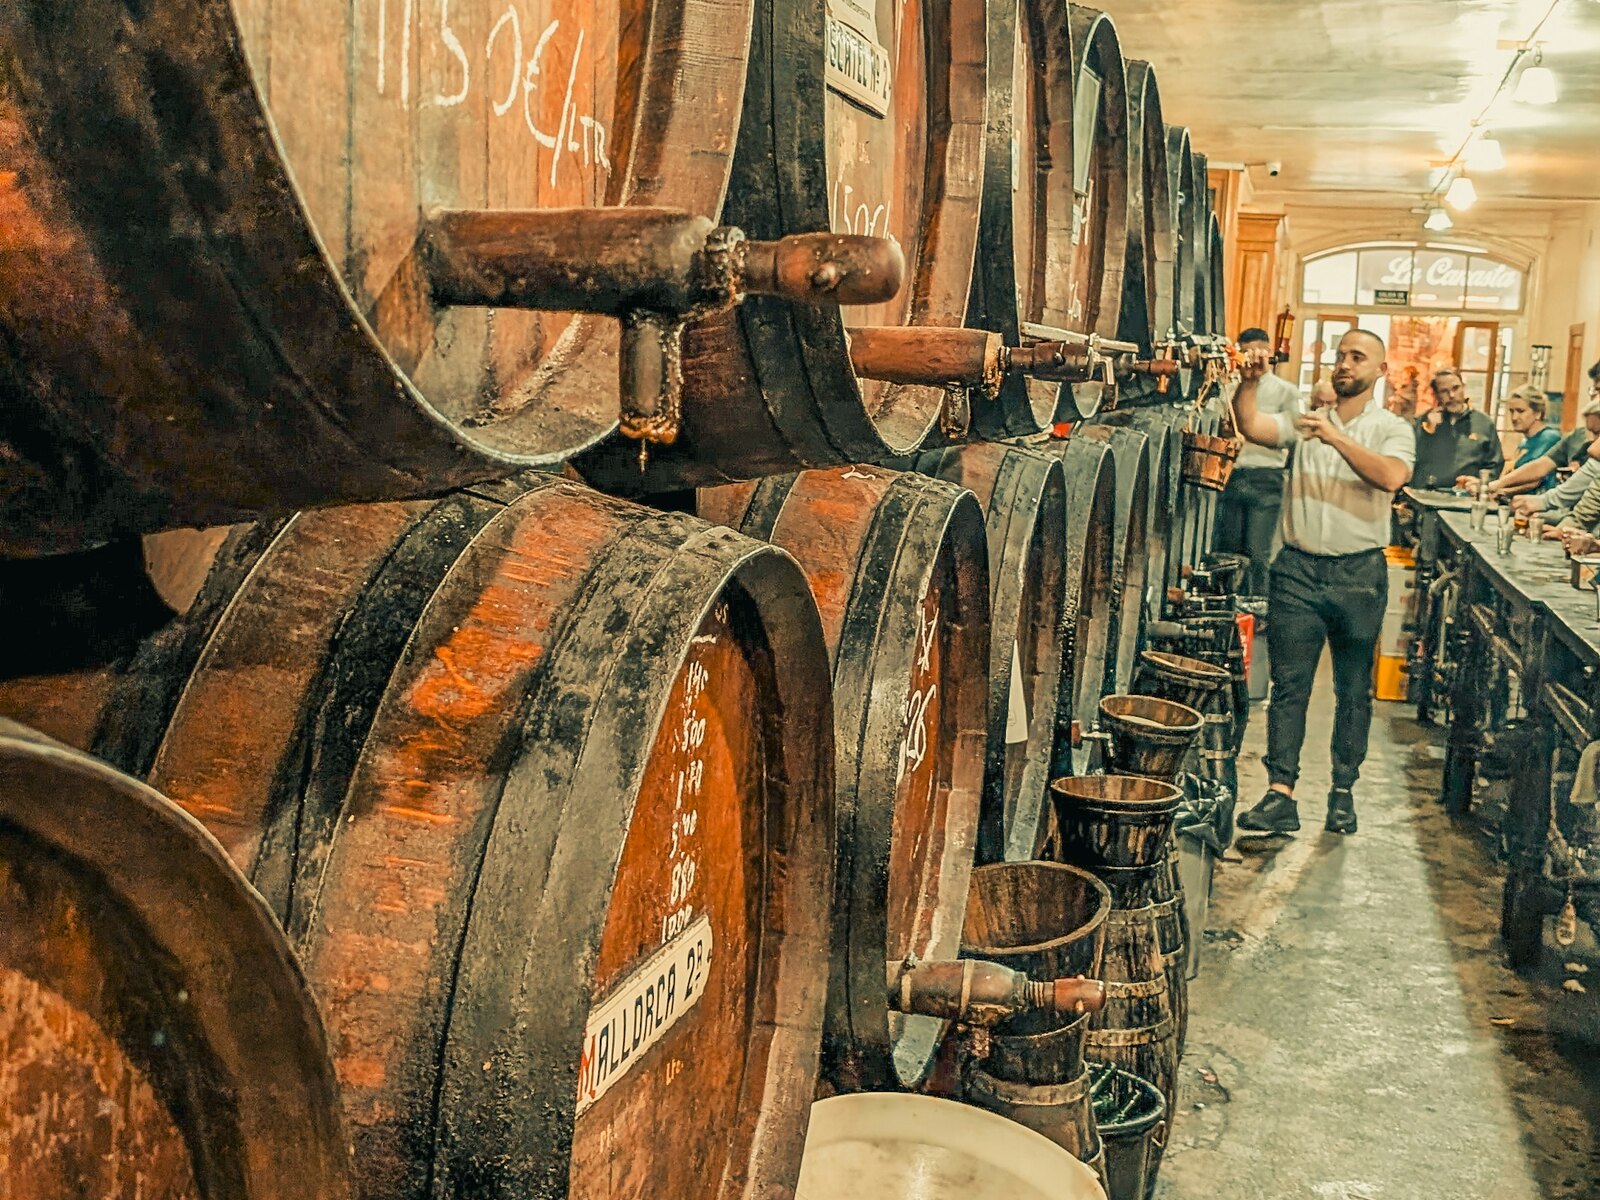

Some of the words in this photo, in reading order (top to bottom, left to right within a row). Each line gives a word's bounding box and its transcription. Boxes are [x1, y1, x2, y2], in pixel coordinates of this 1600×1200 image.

[1381, 256, 1422, 285] La
[1426, 256, 1516, 289] Canasta
[576, 962, 677, 1101] MALLORCA
